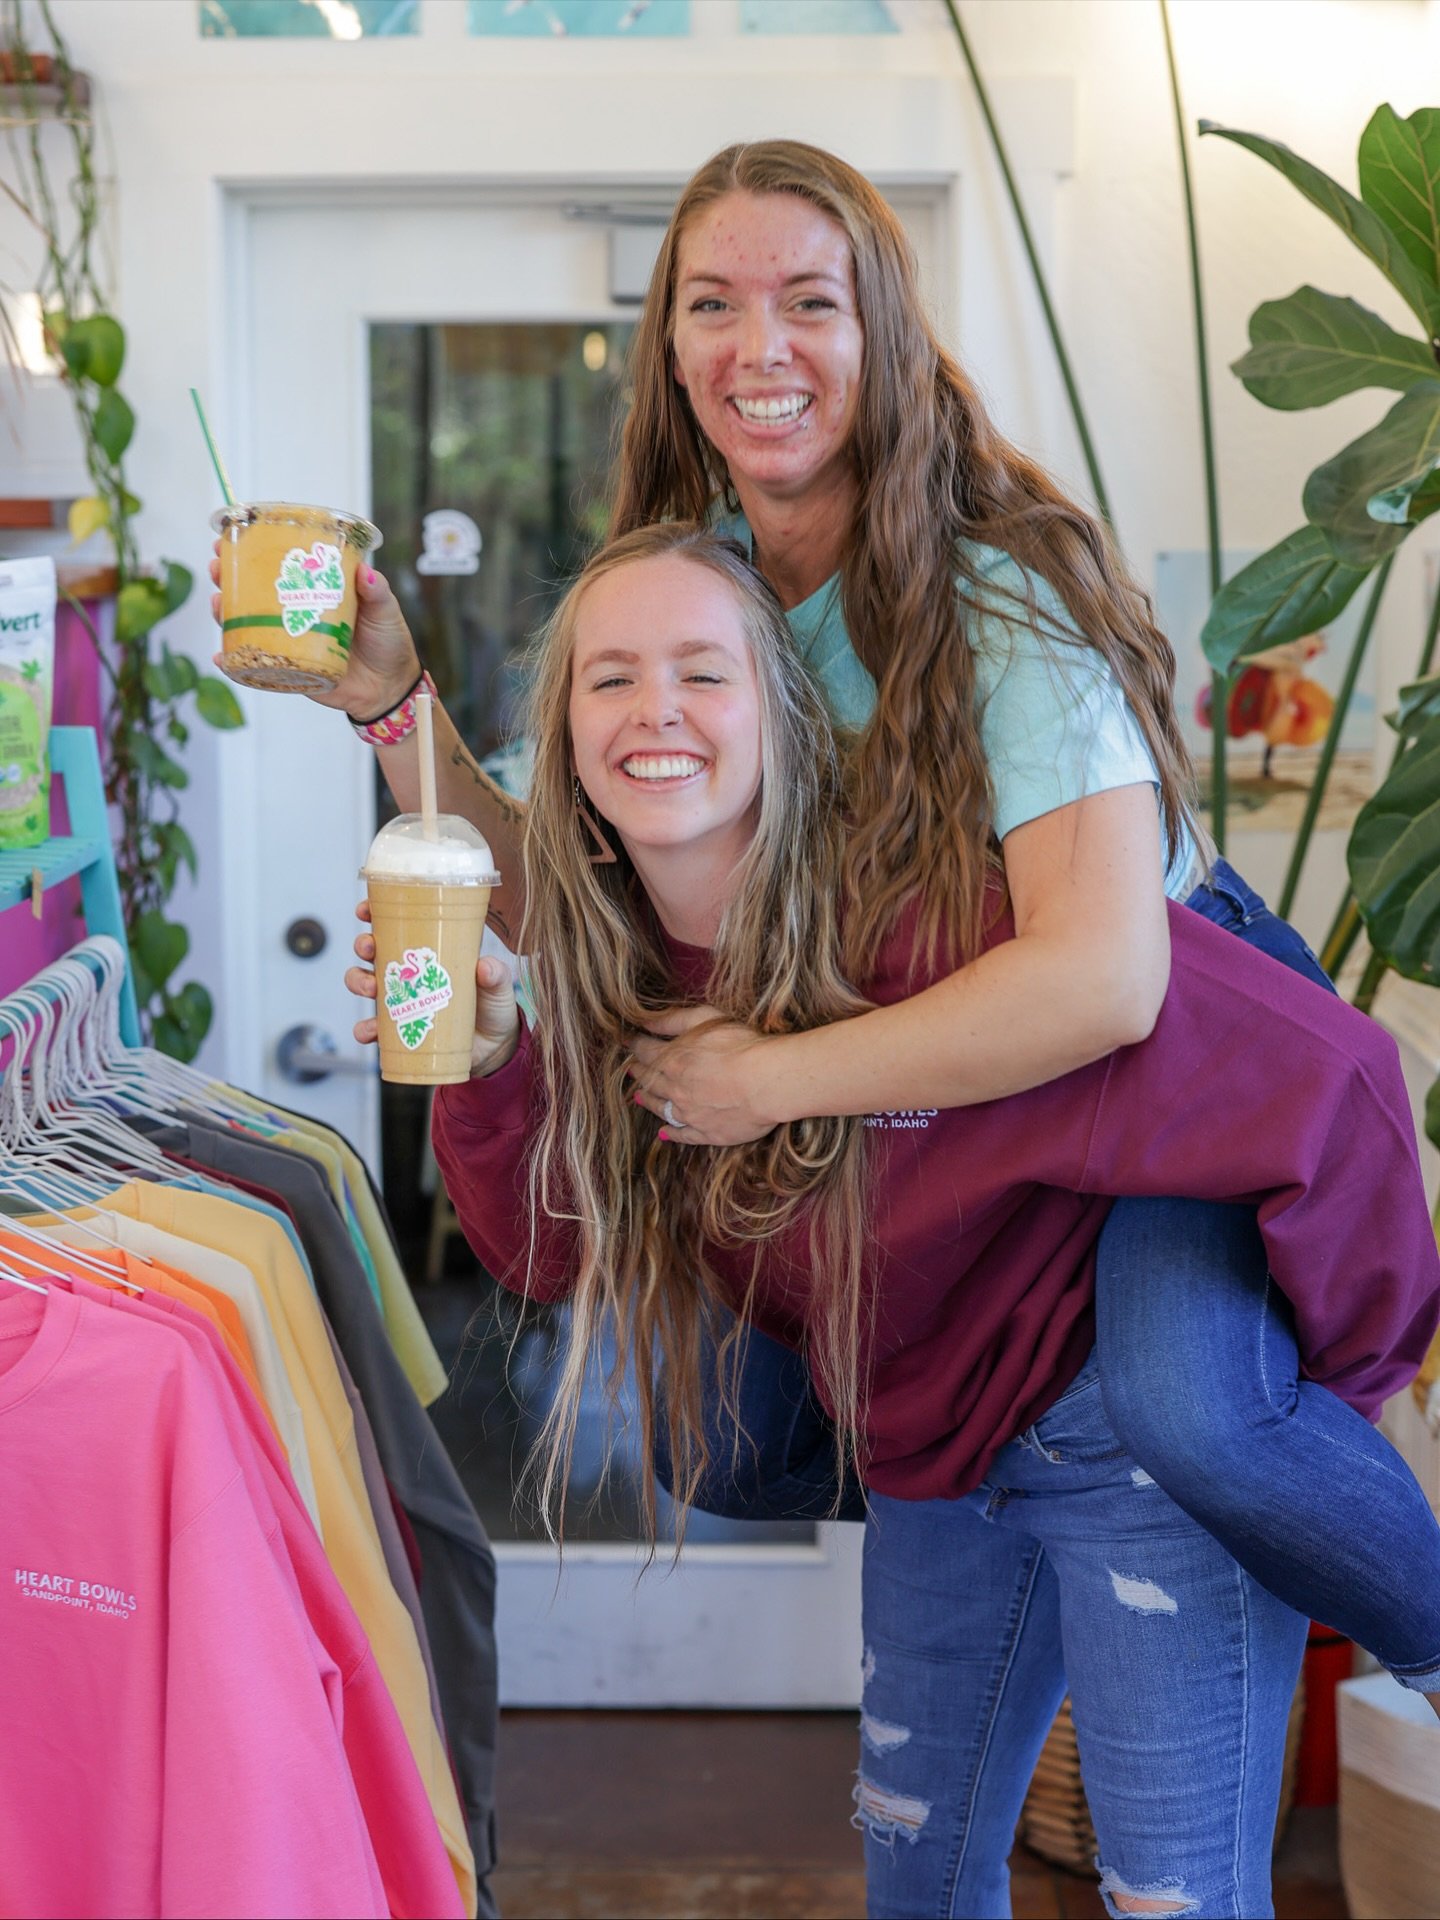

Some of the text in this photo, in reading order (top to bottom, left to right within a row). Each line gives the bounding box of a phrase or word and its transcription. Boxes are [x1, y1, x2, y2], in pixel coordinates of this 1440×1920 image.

[391, 1002, 417, 1017] HEART
[419, 988, 450, 1008] BOWLS
[891, 1118, 929, 1128] IDAHO
[15, 1569, 137, 1611] HEART BOWLS
[22, 1587, 129, 1620] SANDPOINT, IDAHO
